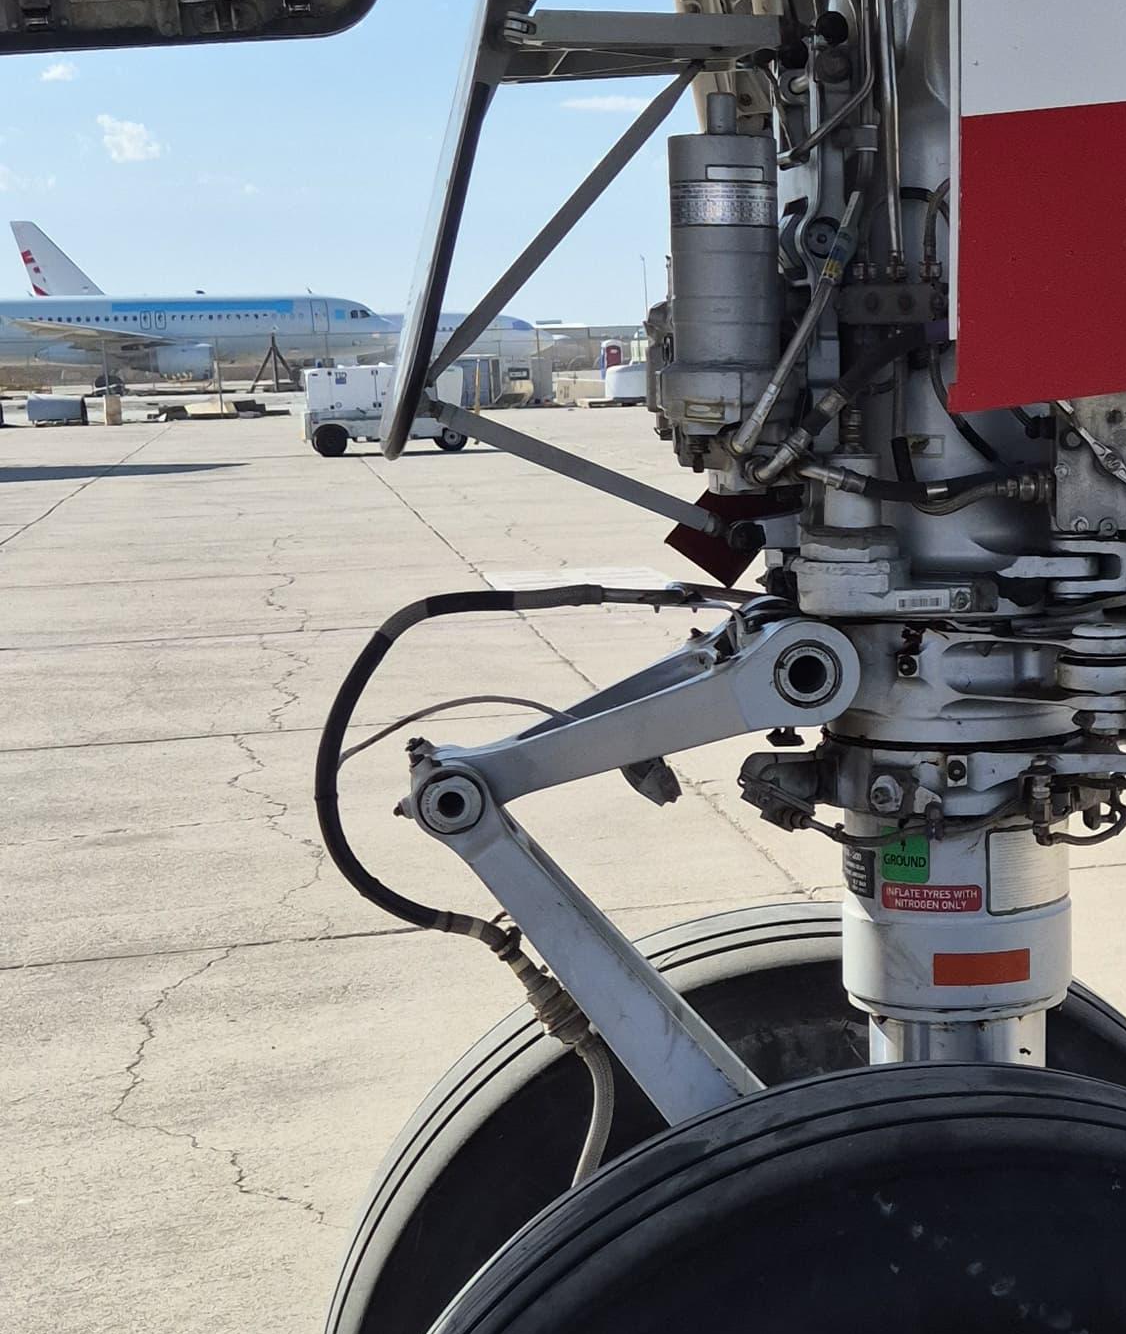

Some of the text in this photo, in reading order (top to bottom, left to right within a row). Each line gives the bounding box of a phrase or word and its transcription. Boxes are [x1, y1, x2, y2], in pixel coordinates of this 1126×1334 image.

[884, 854, 926, 868] GROUND
[886, 886, 977, 899] INFLATE TYRES WITH
[895, 899, 967, 910] NITROGEN ONLY
